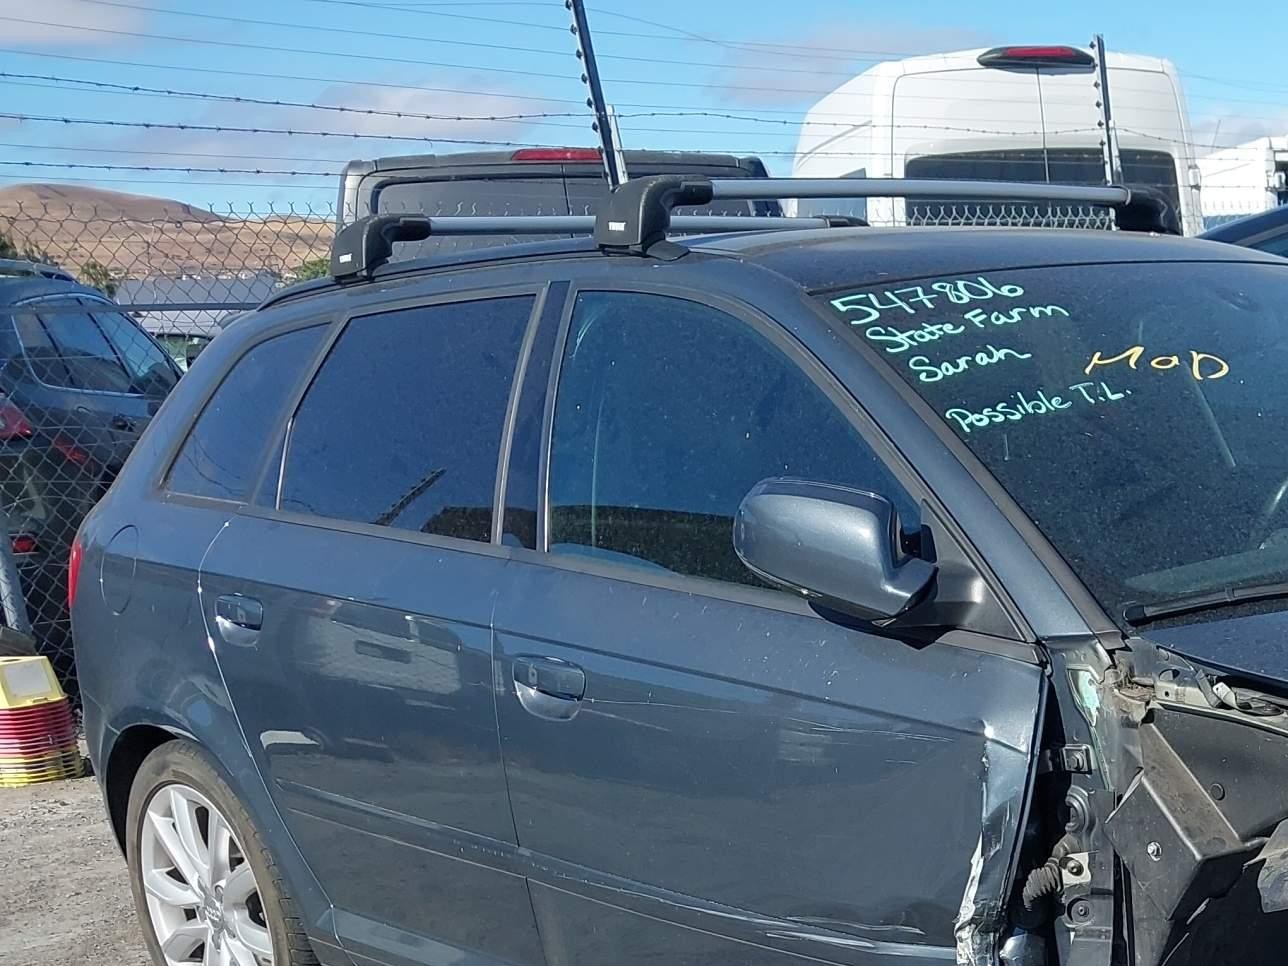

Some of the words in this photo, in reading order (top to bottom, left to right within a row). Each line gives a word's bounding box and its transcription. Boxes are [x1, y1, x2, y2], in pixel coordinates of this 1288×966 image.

[830, 276, 1025, 325] 547806
[866, 322, 966, 353] State
[963, 304, 1070, 328] Farm
[908, 344, 1033, 383] Sarah
[945, 390, 1073, 433] Possible
